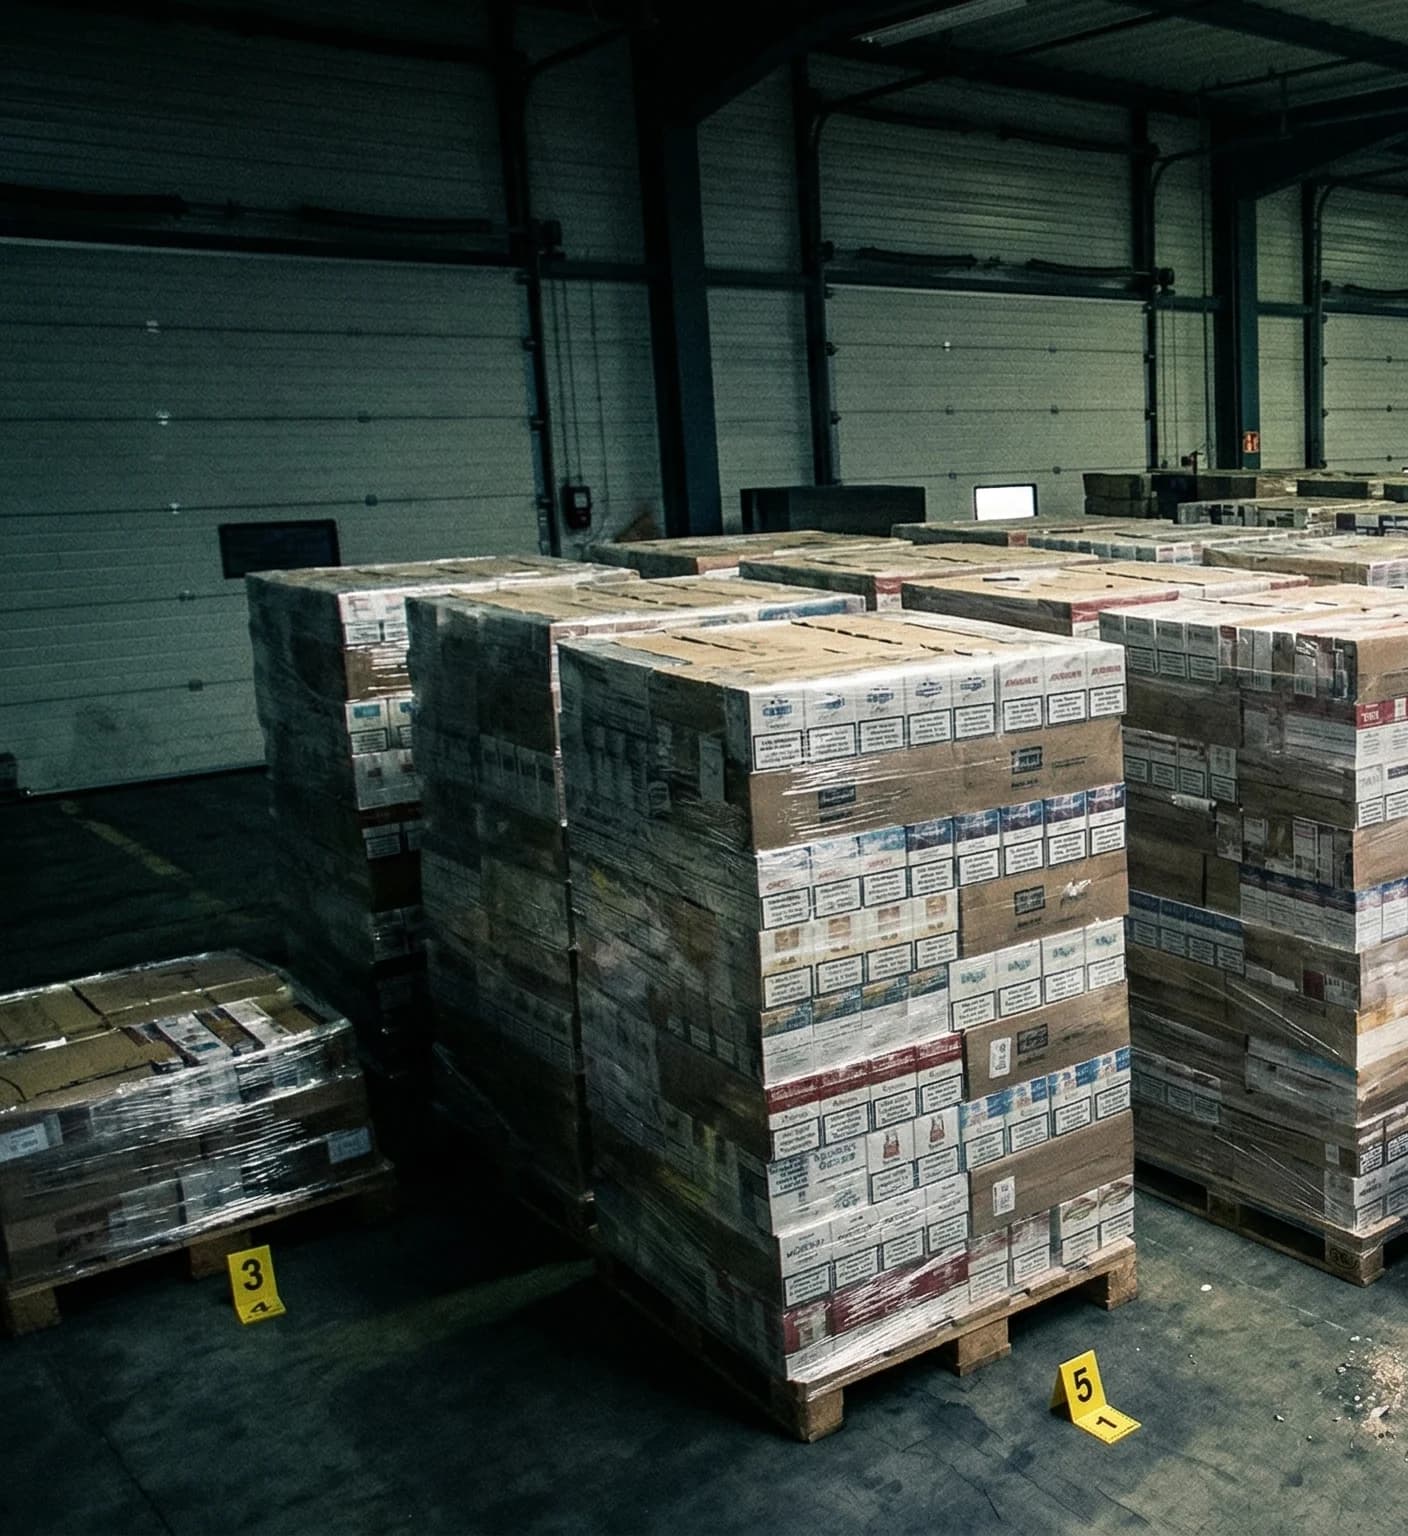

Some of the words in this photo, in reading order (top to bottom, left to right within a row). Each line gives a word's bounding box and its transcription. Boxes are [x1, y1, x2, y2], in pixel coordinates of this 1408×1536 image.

[241, 1258, 264, 1291] 3
[1073, 1366, 1093, 1403] 5
[1096, 1415, 1118, 1429] 1
